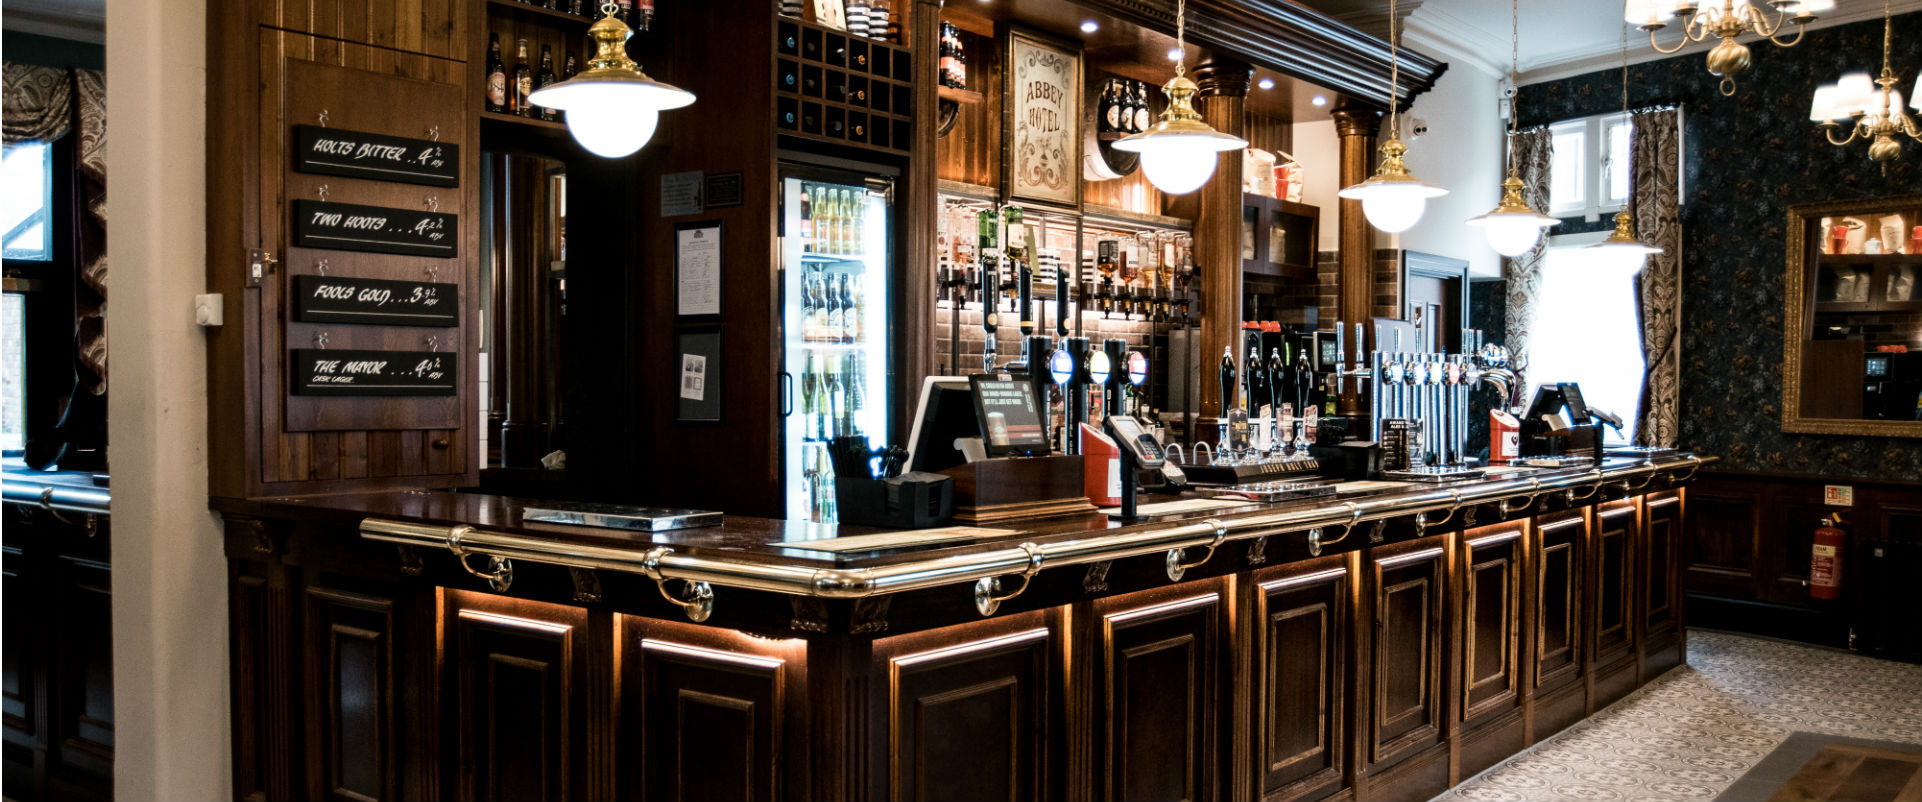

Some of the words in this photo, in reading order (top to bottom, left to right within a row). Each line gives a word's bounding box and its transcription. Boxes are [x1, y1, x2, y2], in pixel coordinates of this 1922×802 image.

[1026, 80, 1064, 109] ABBEY
[1029, 107, 1060, 133] HOTEL
[313, 139, 356, 155] HOLTS
[355, 143, 407, 160] BITTER
[311, 212, 342, 226] TWO
[343, 215, 387, 230] HOOTS
[313, 285, 356, 299] FOOLS
[358, 288, 391, 306] GOLD
[313, 360, 341, 374] THE
[341, 361, 388, 375] MAYOR
[312, 375, 331, 383] CASK
